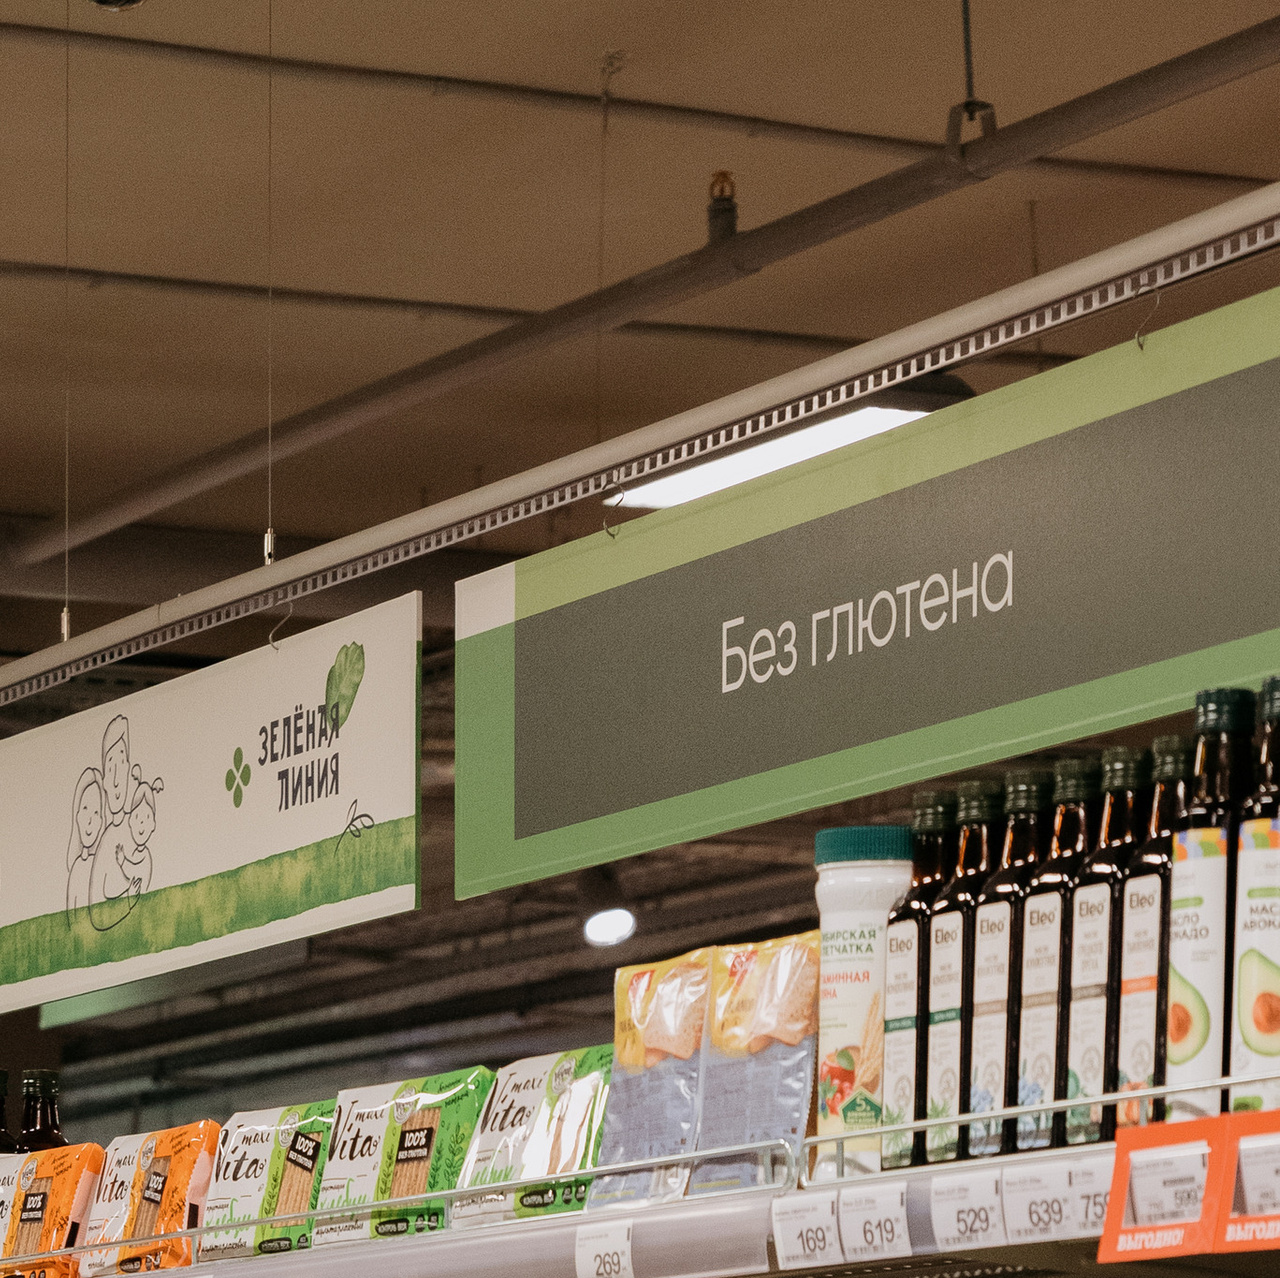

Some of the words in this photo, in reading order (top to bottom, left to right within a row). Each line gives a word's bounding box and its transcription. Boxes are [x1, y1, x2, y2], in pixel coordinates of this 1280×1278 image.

[720, 617, 798, 694] Без
[810, 549, 1015, 665] глютена
[258, 702, 340, 767] ЗЕЛЁНАЯ
[277, 752, 340, 813] ЛИНИЯ
